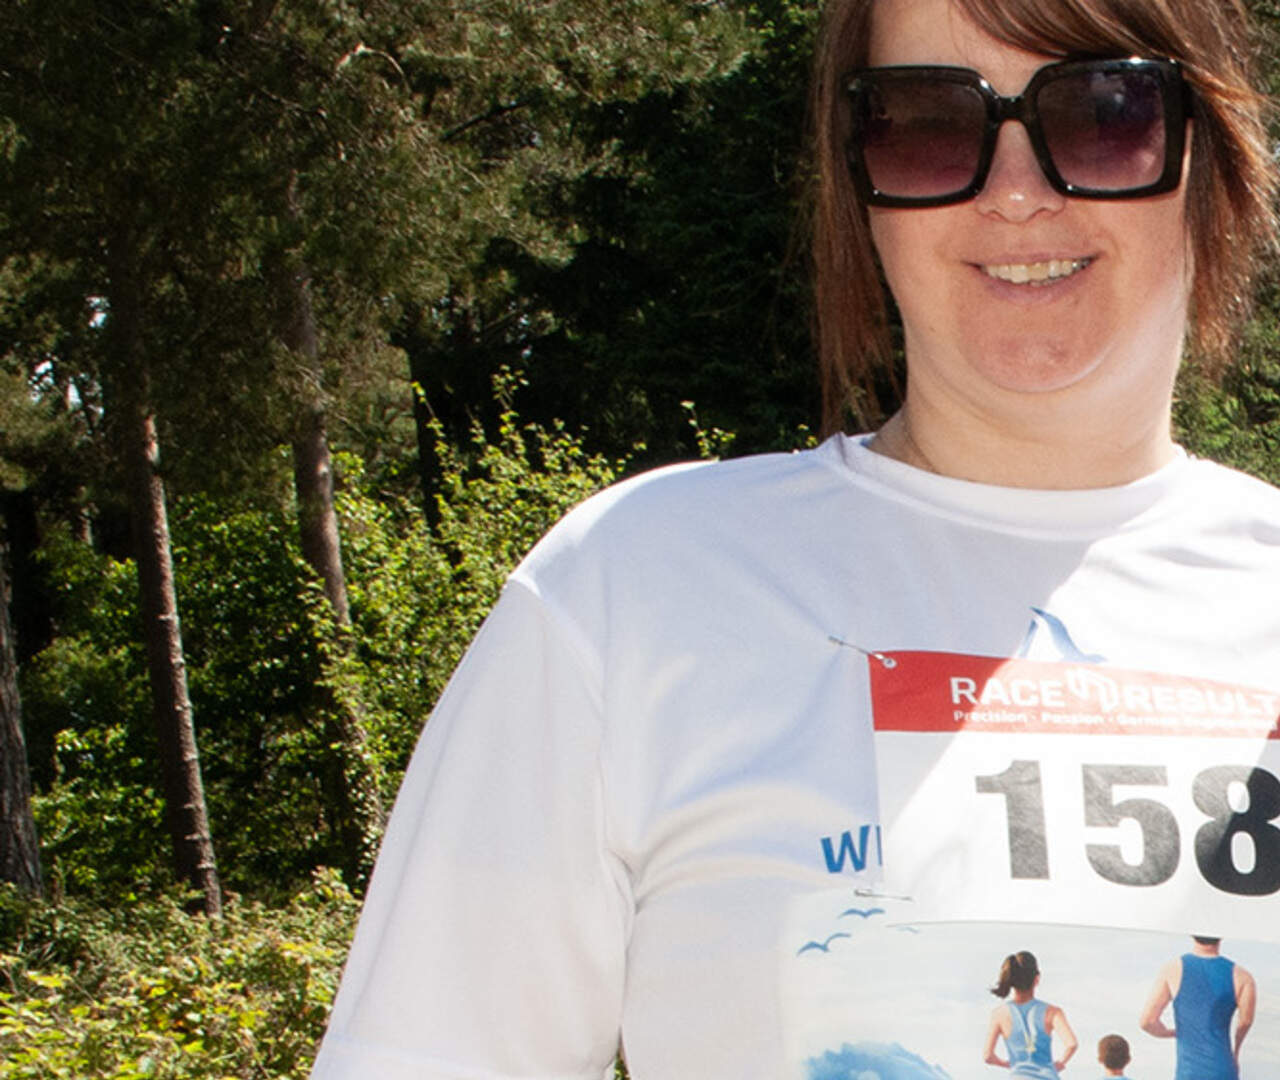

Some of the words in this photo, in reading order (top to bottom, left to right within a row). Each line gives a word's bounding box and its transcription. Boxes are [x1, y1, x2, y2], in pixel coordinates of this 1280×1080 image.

[950, 675, 1066, 708] RACE
[1126, 685, 1278, 718] RESULT
[953, 709, 1027, 724] Precision
